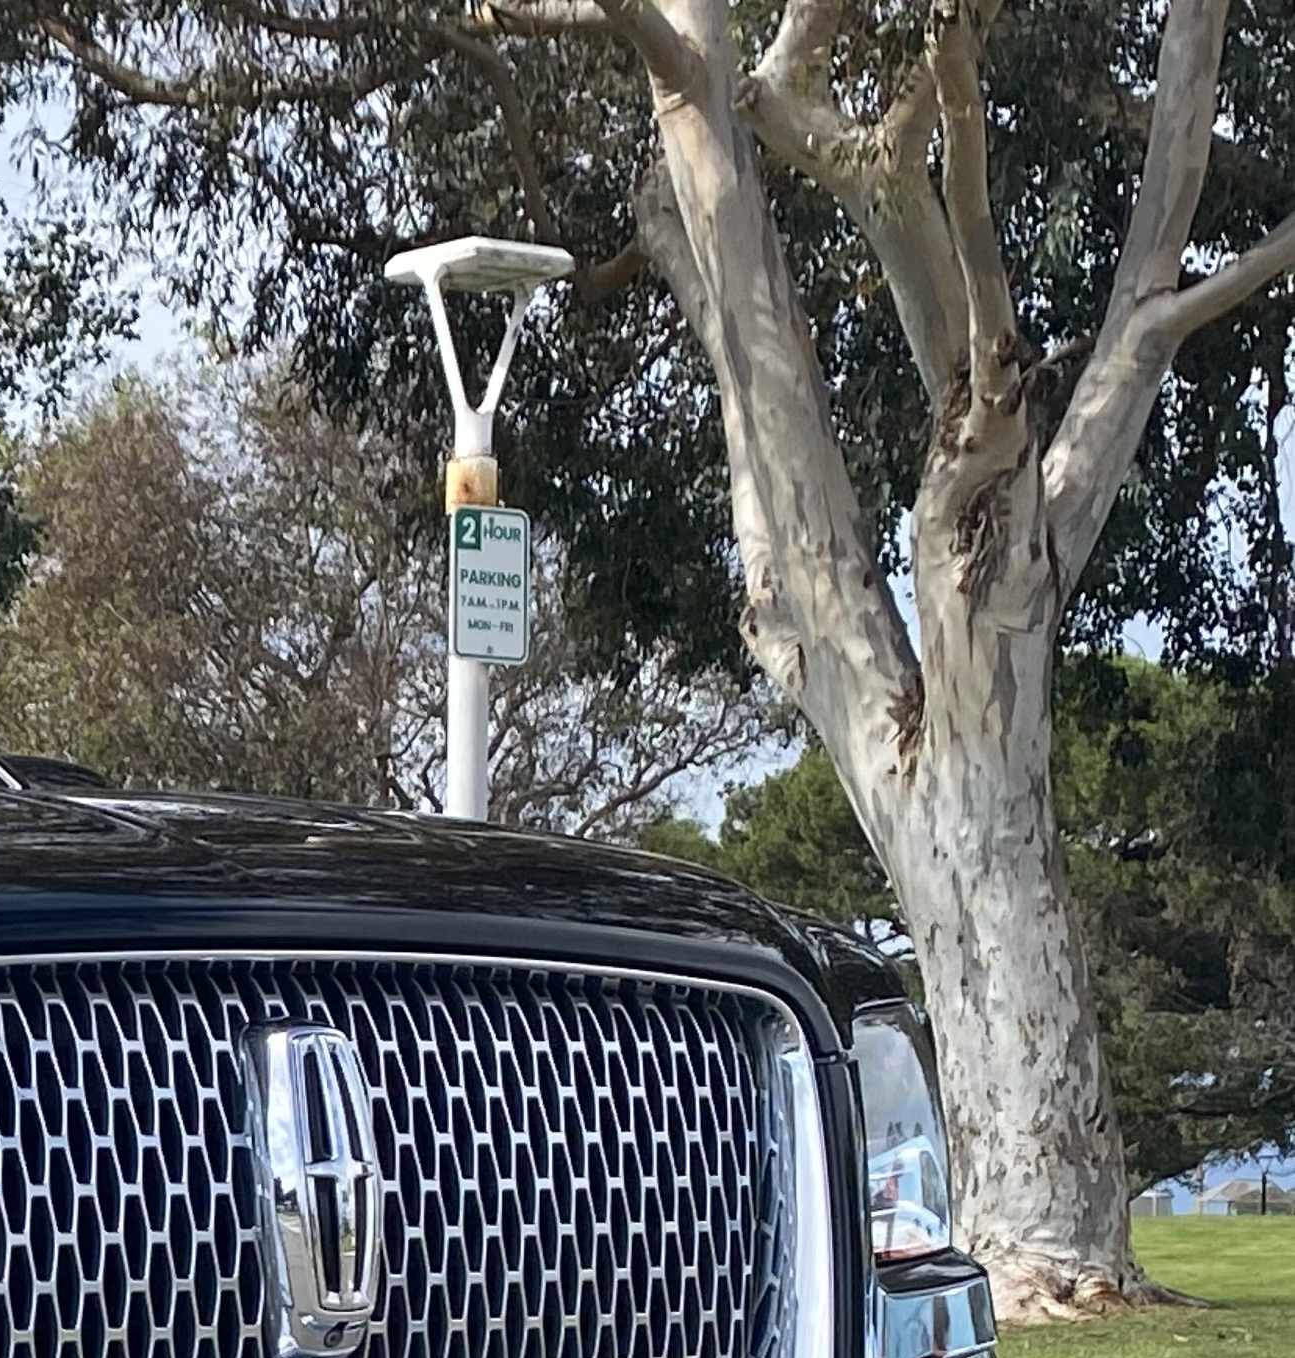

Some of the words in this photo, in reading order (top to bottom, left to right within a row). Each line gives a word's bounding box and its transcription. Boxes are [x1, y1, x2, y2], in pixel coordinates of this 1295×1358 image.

[462, 516, 477, 544] 2
[483, 525, 522, 543] HOUR
[461, 568, 522, 589] PARKING
[467, 618, 491, 630] MON
[499, 620, 513, 634] FRI
